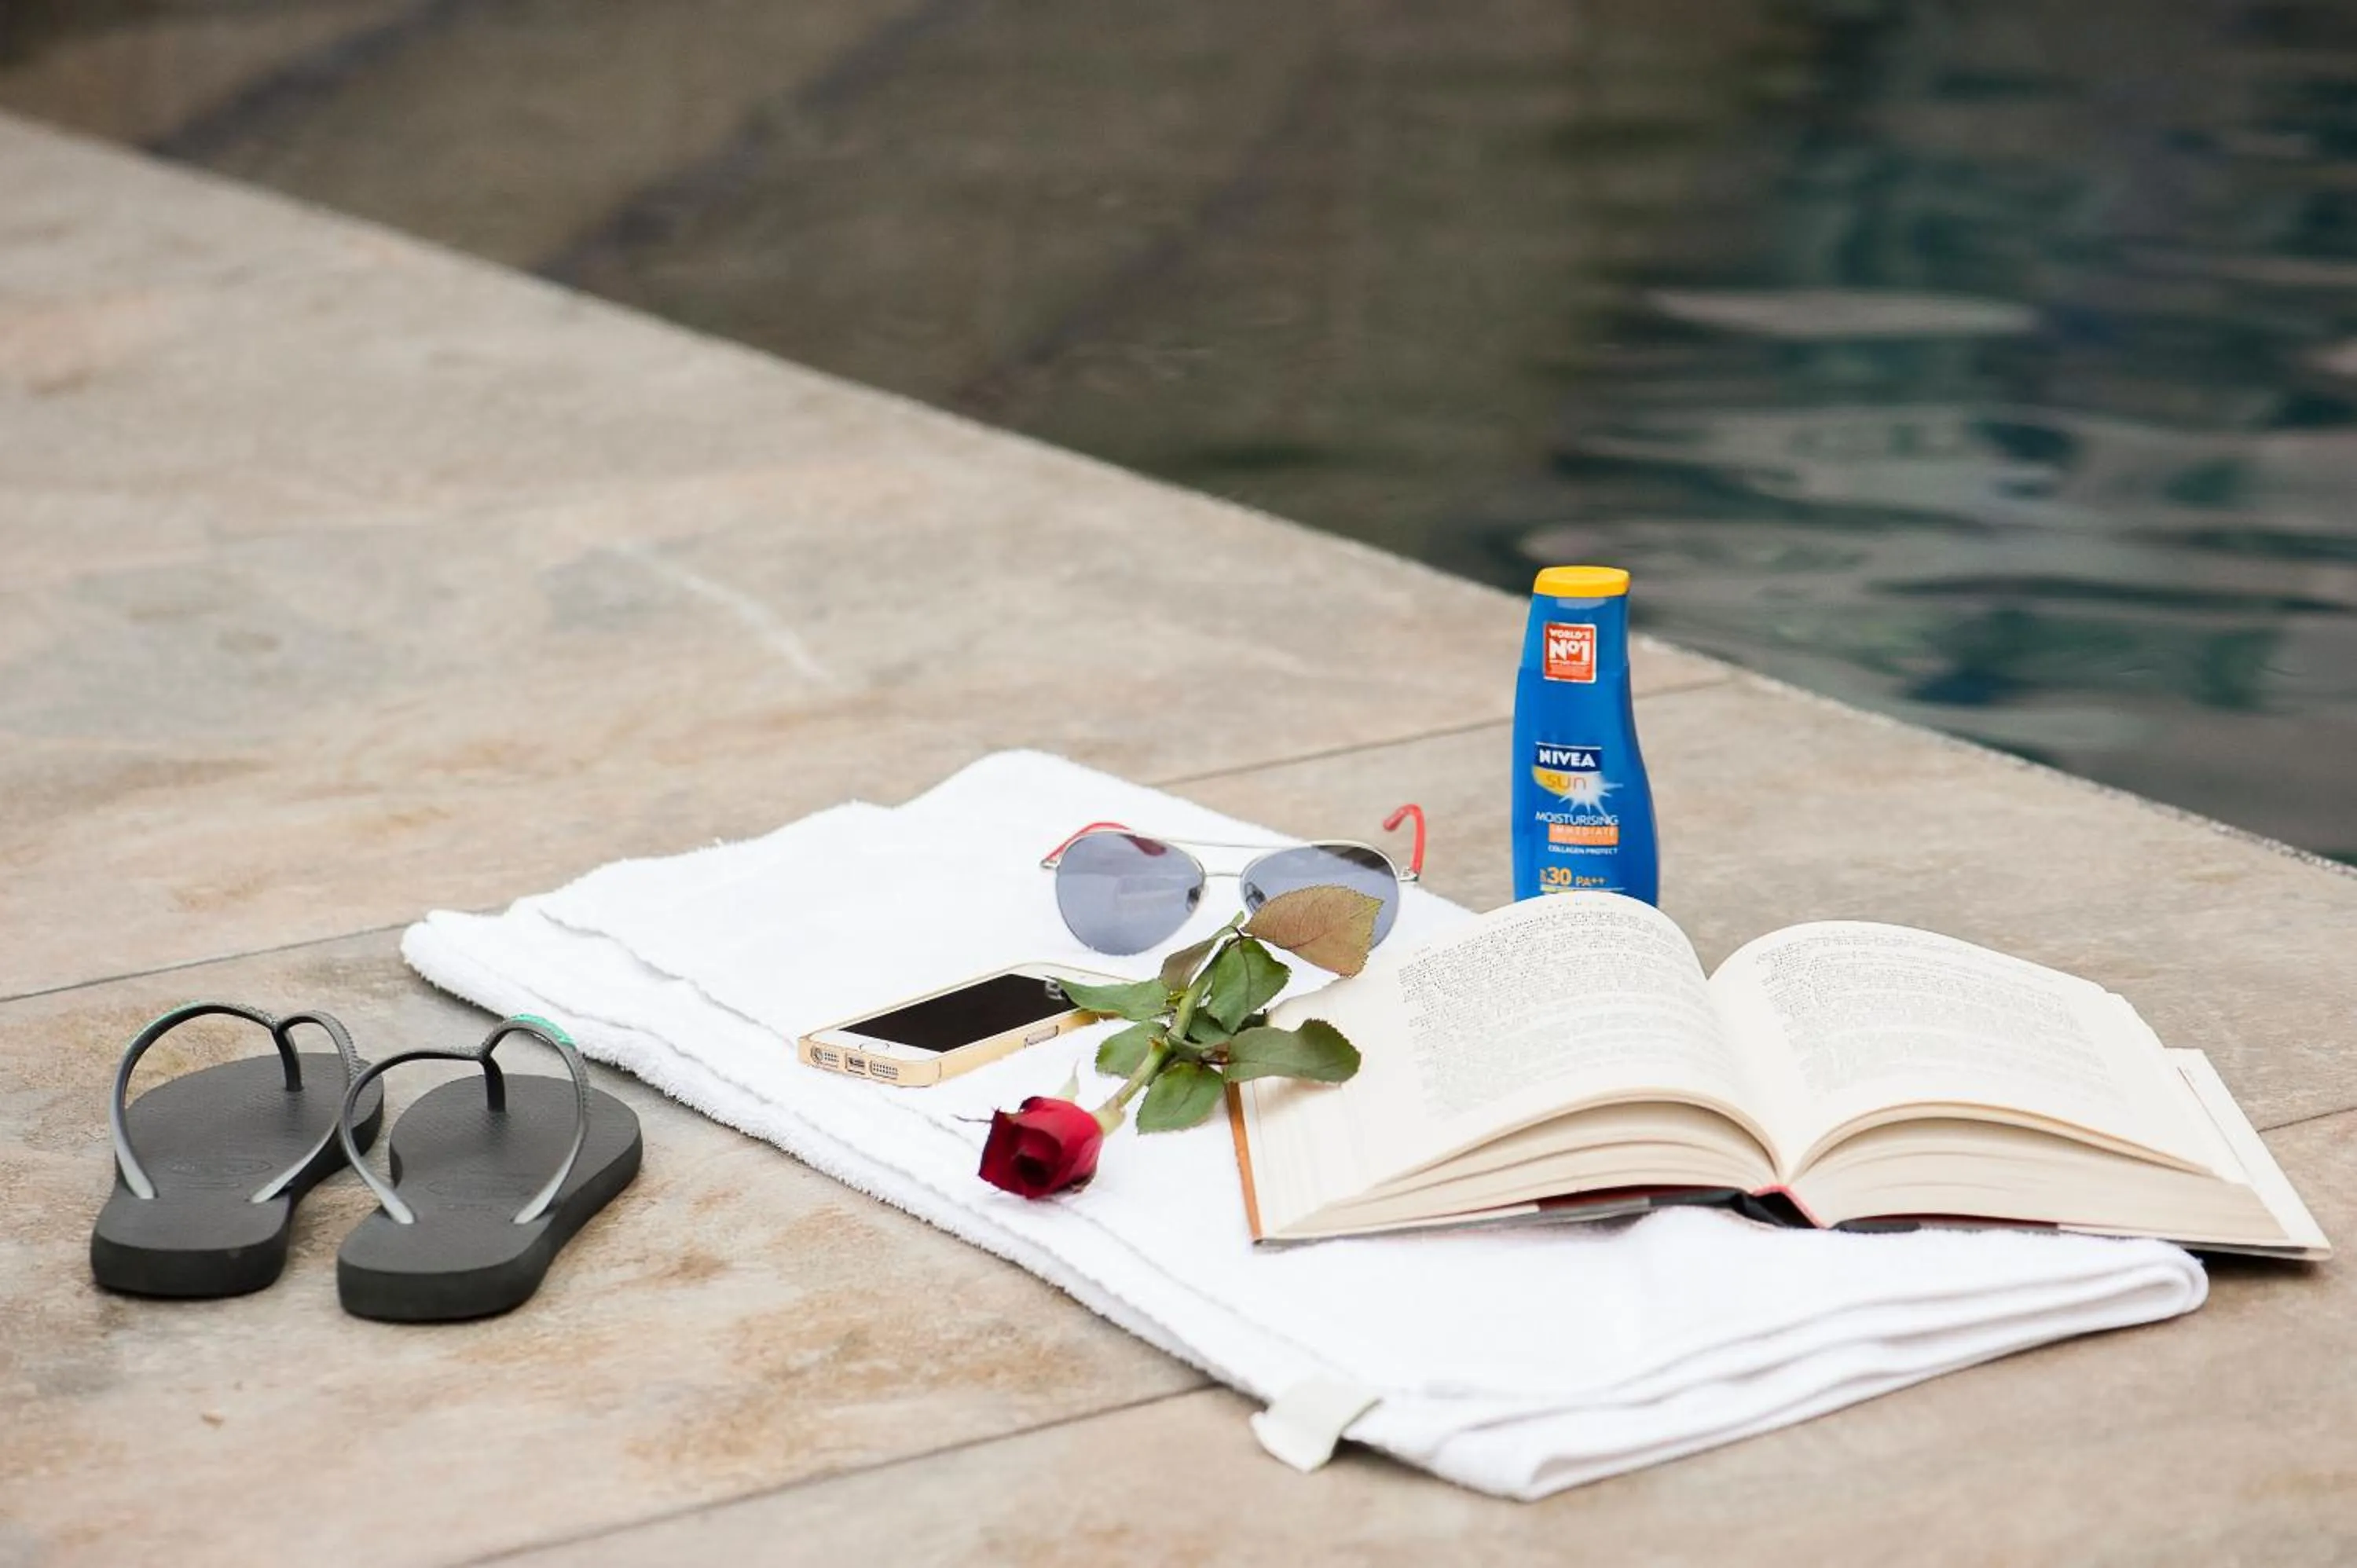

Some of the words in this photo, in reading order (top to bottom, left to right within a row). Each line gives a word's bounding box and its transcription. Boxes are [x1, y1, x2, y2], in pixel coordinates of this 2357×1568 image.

[1539, 749, 1596, 768] NIVEA
[1535, 811, 1618, 826] MOISTURISING
[1548, 866, 1571, 885] 30
